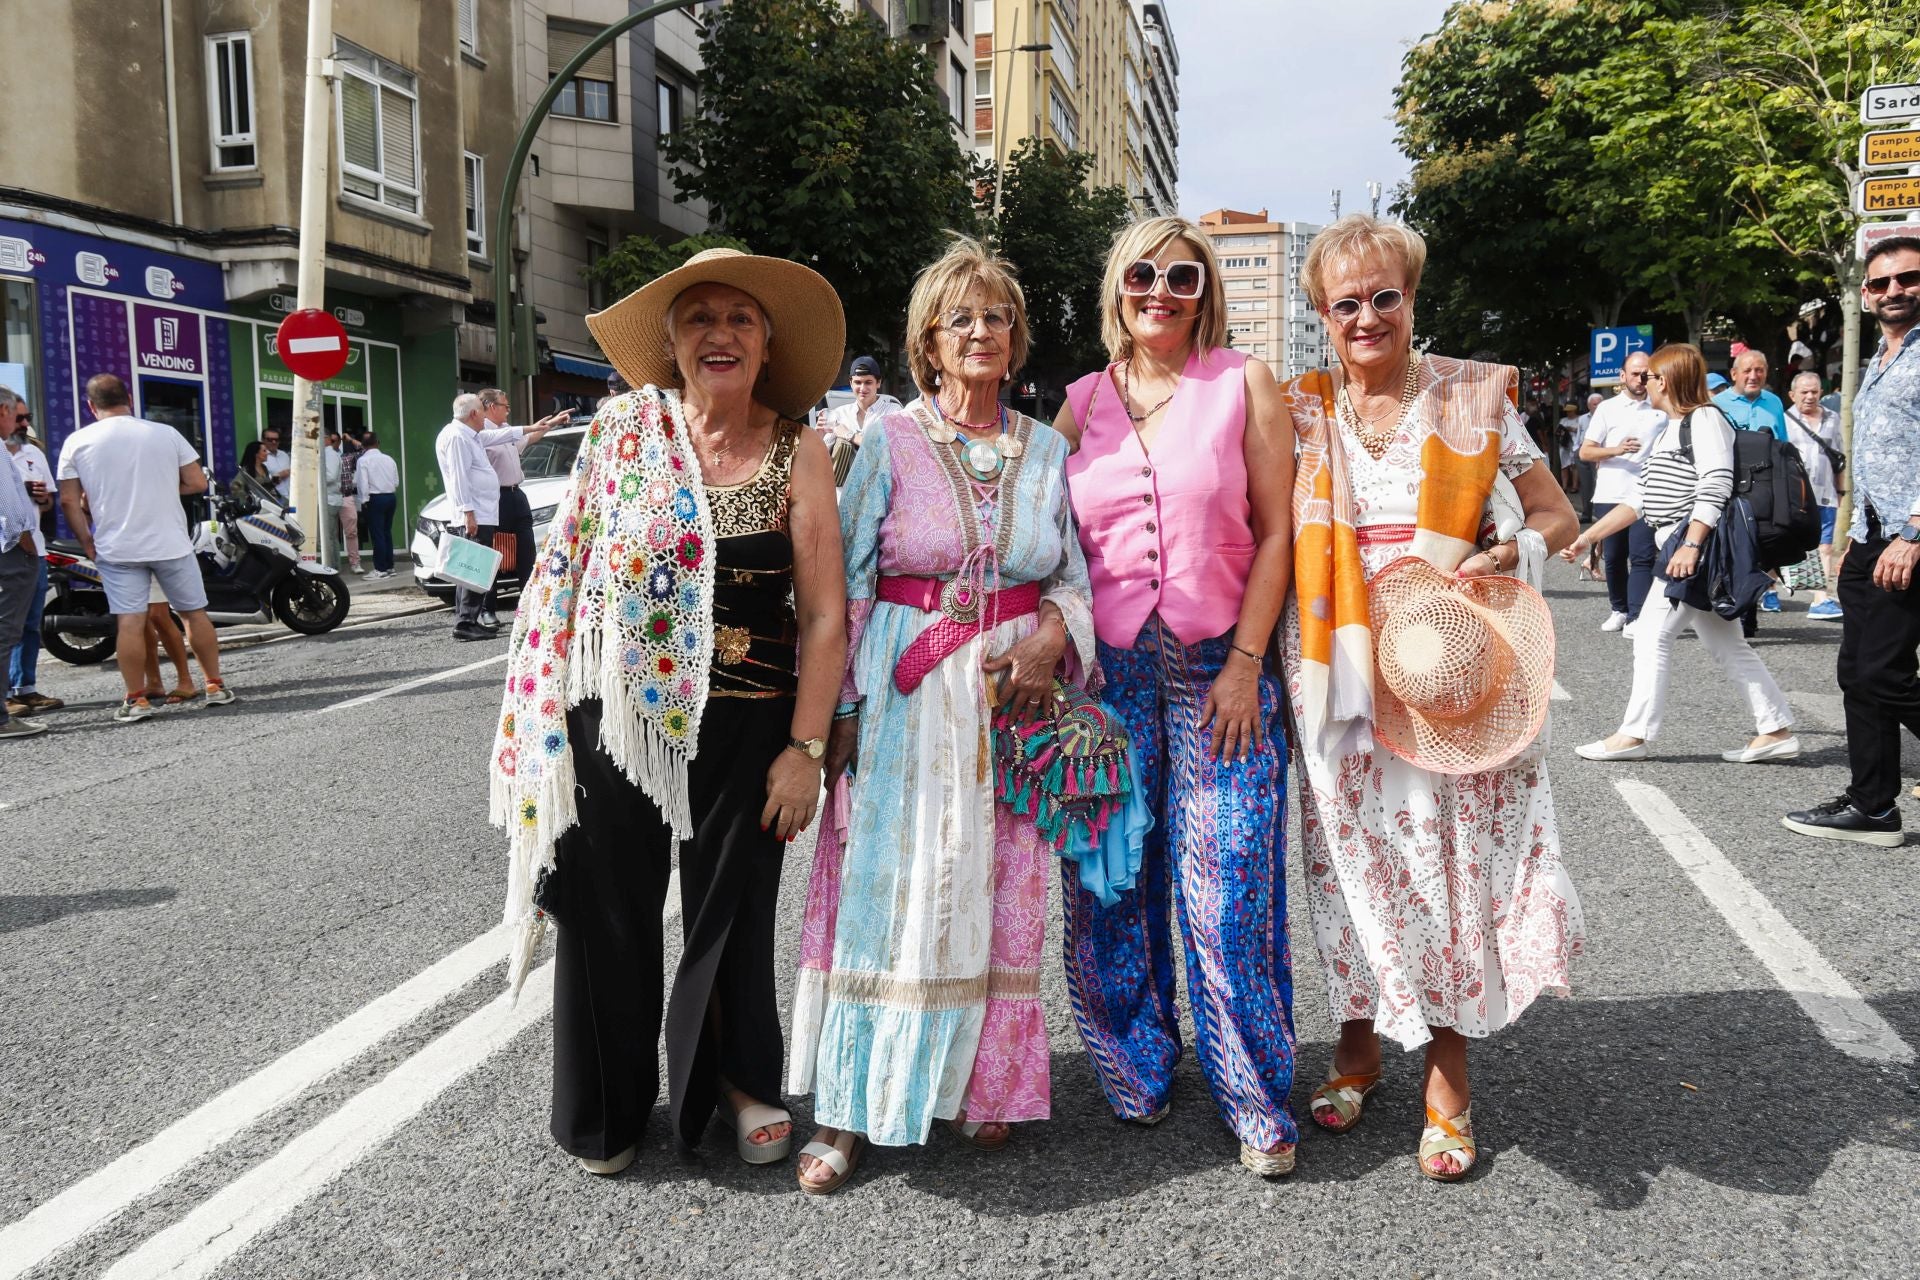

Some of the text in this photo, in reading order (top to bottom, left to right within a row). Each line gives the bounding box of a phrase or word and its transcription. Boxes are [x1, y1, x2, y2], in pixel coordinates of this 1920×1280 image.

[1872, 137, 1910, 146] campo
[1871, 148, 1920, 160] Palacio
[1870, 182, 1908, 191] campo
[28, 251, 46, 263] 24h
[104, 266, 119, 278] 24h
[171, 281, 185, 291] 24h
[1595, 332, 1618, 364] P
[141, 352, 195, 371] VENDING
[1595, 368, 1614, 376] PLAZA
[330, 382, 355, 392] MUCHO
